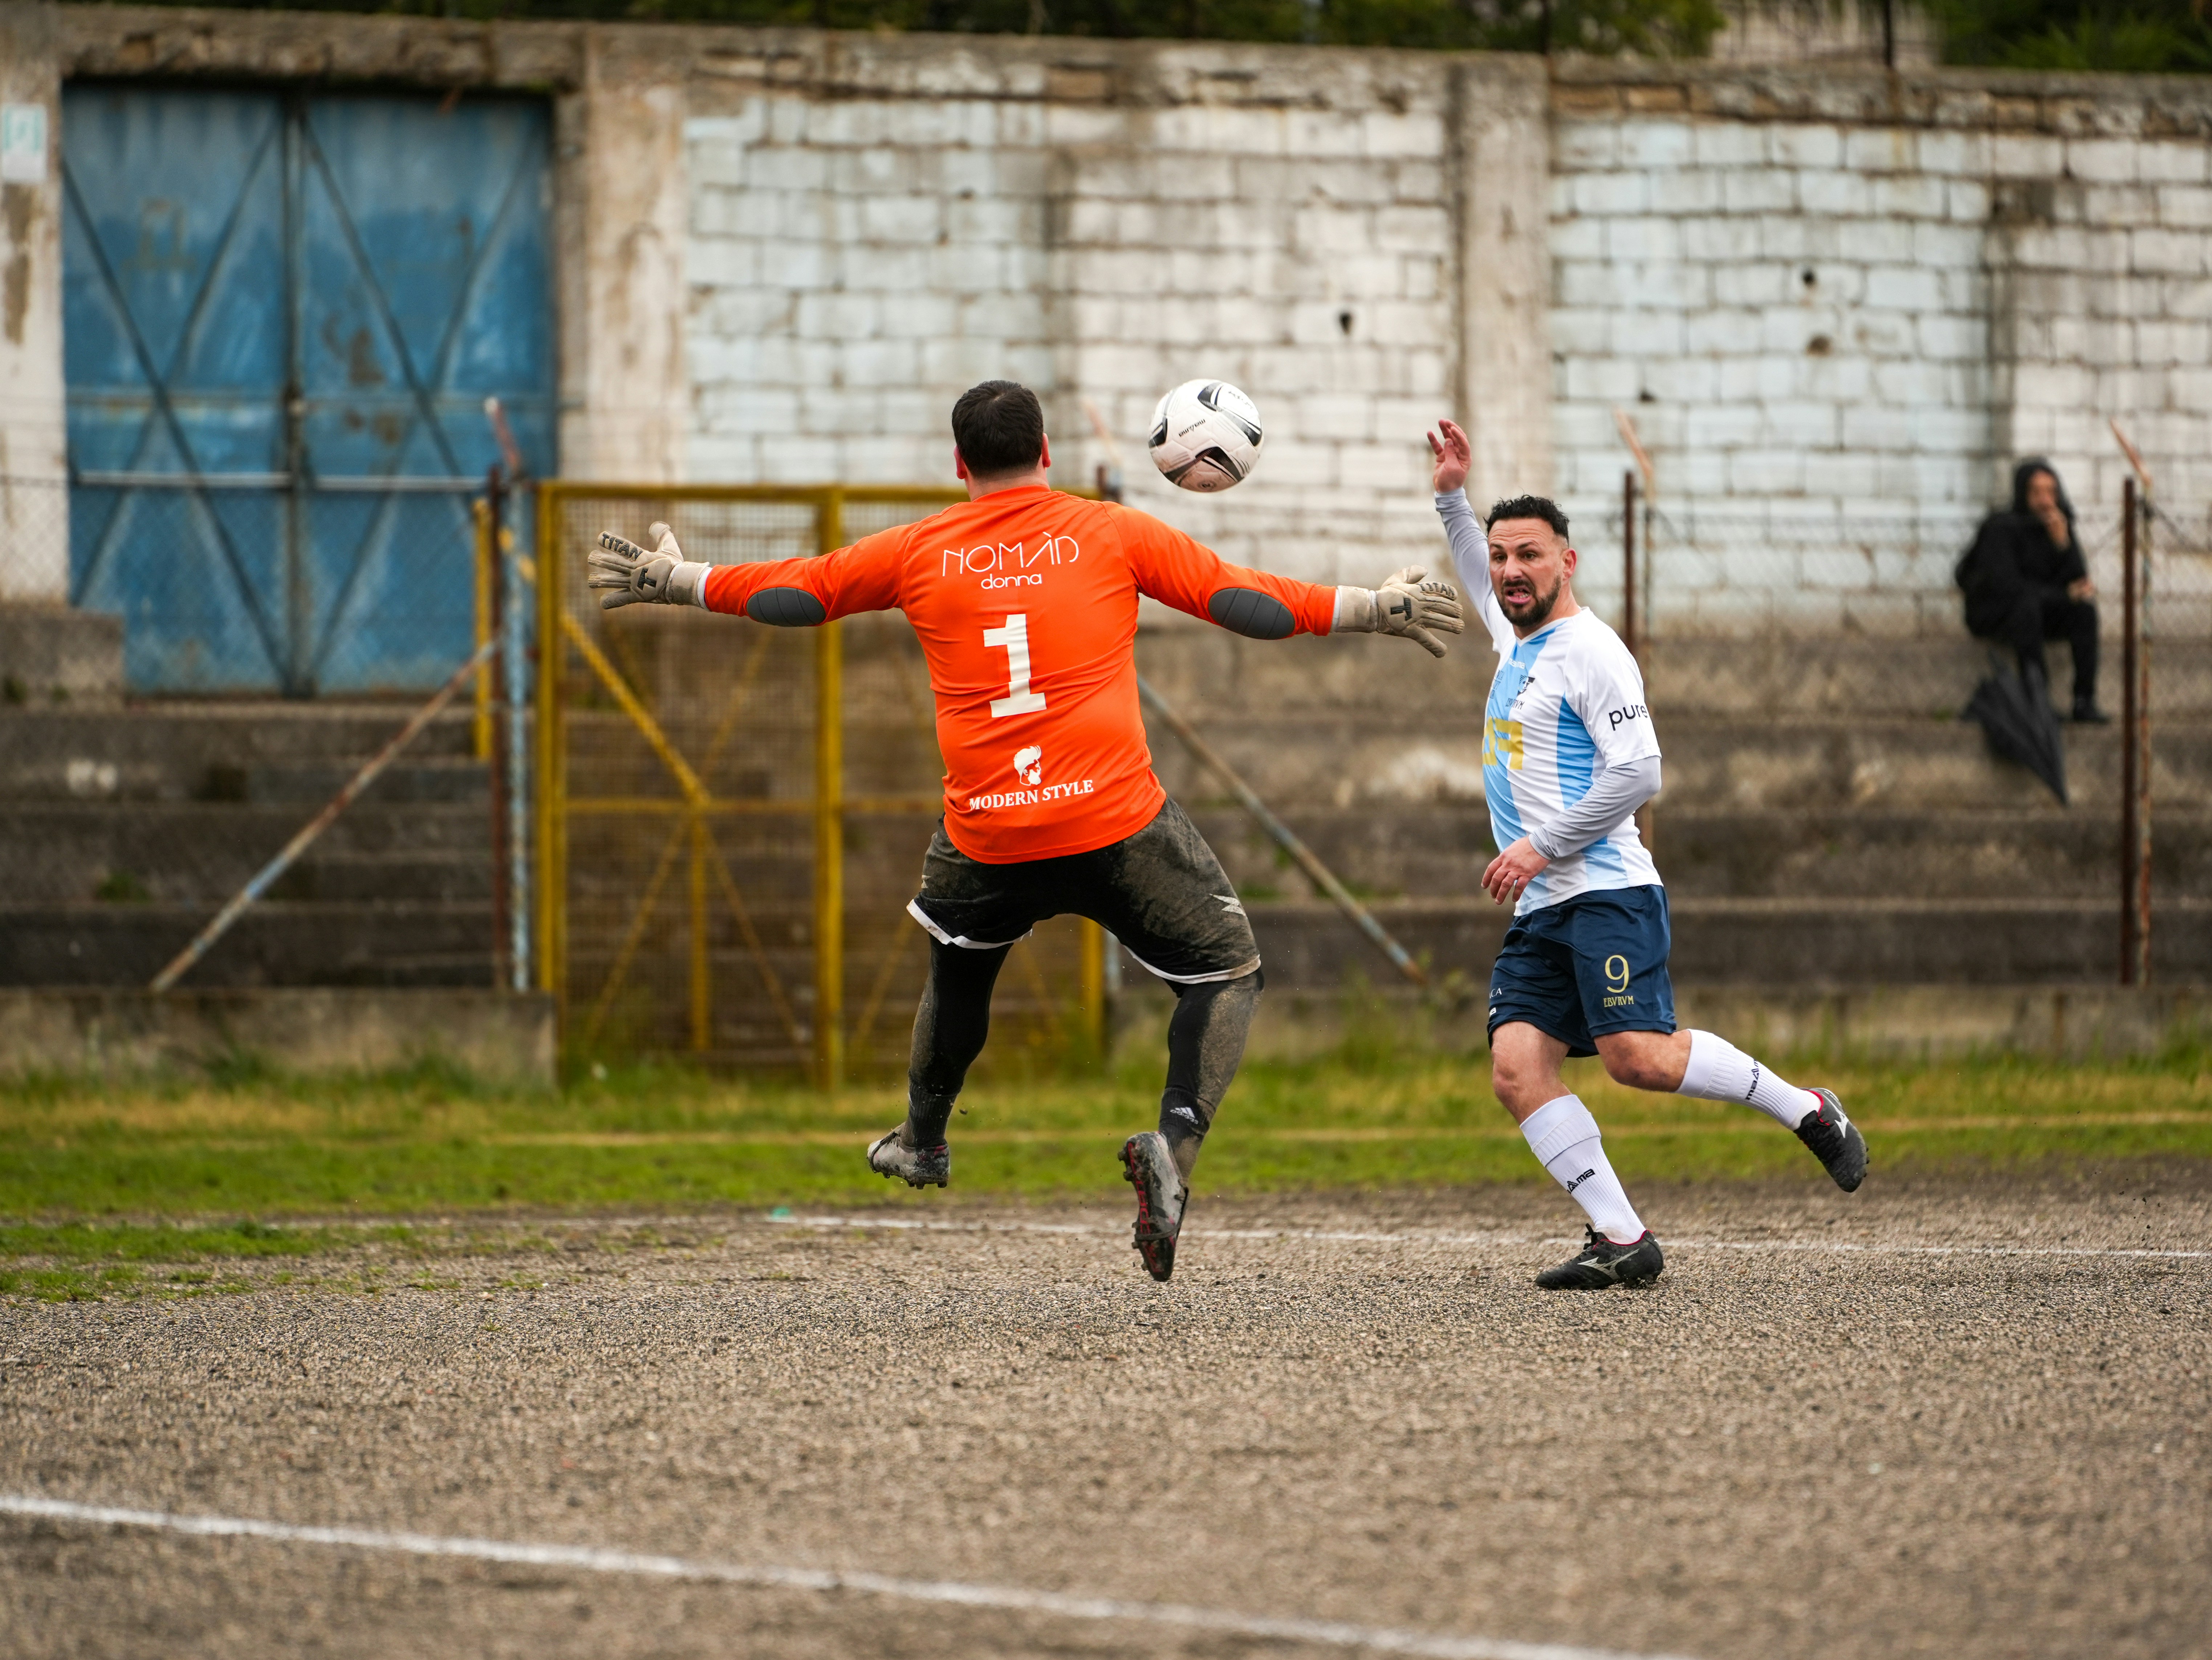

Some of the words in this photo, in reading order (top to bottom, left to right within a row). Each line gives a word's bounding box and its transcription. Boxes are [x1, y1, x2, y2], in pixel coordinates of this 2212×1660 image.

[602, 533, 643, 560] TITAN
[981, 573, 1042, 590] donna
[983, 613, 1047, 718] 1
[1609, 705, 1648, 731] pure
[969, 790, 1038, 811] MODERN
[1042, 779, 1094, 801] STYLE
[1605, 955, 1629, 993] 9
[1603, 996, 1634, 1007] EBVRVM
[1170, 1109, 1199, 1125] adidas
